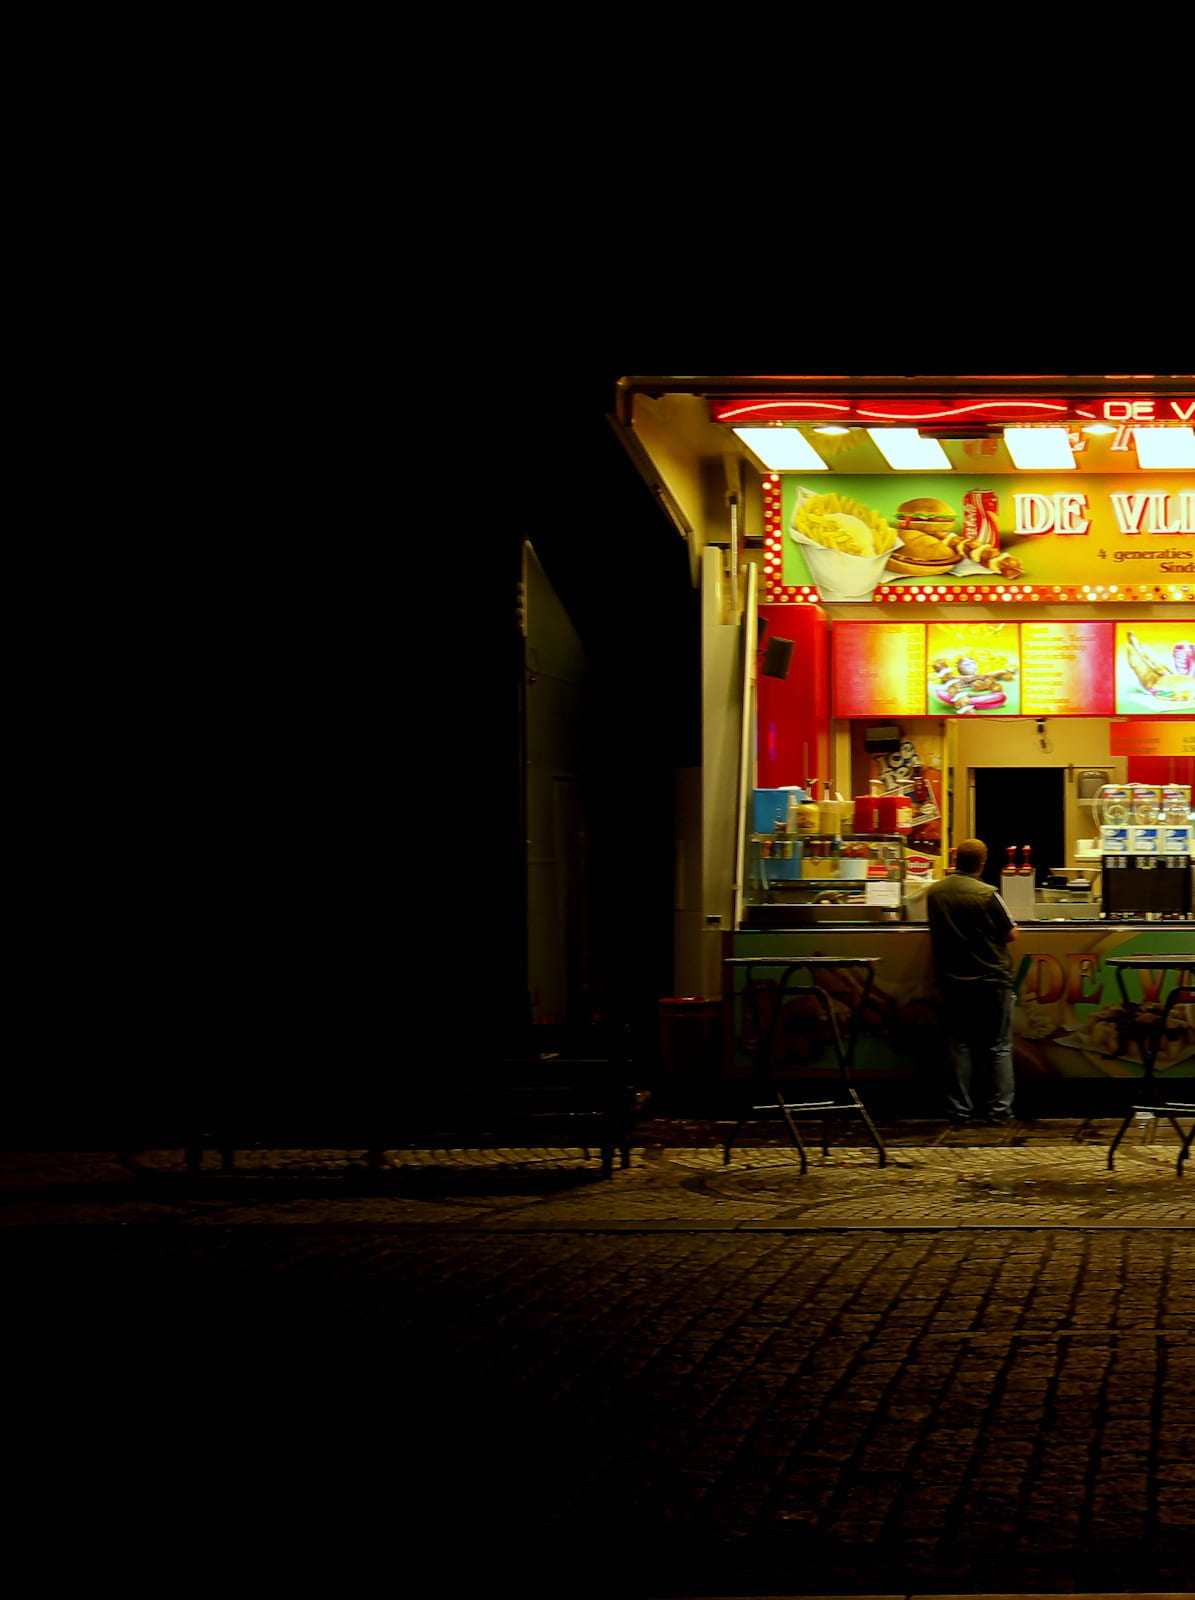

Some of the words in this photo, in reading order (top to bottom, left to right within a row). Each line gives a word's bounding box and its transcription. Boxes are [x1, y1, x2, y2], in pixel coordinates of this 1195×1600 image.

[1103, 400, 1156, 420] DE
[1012, 492, 1092, 536] DE
[1098, 549, 1107, 560] 4
[1113, 547, 1193, 562] generaties
[1024, 953, 1104, 1004] DE
